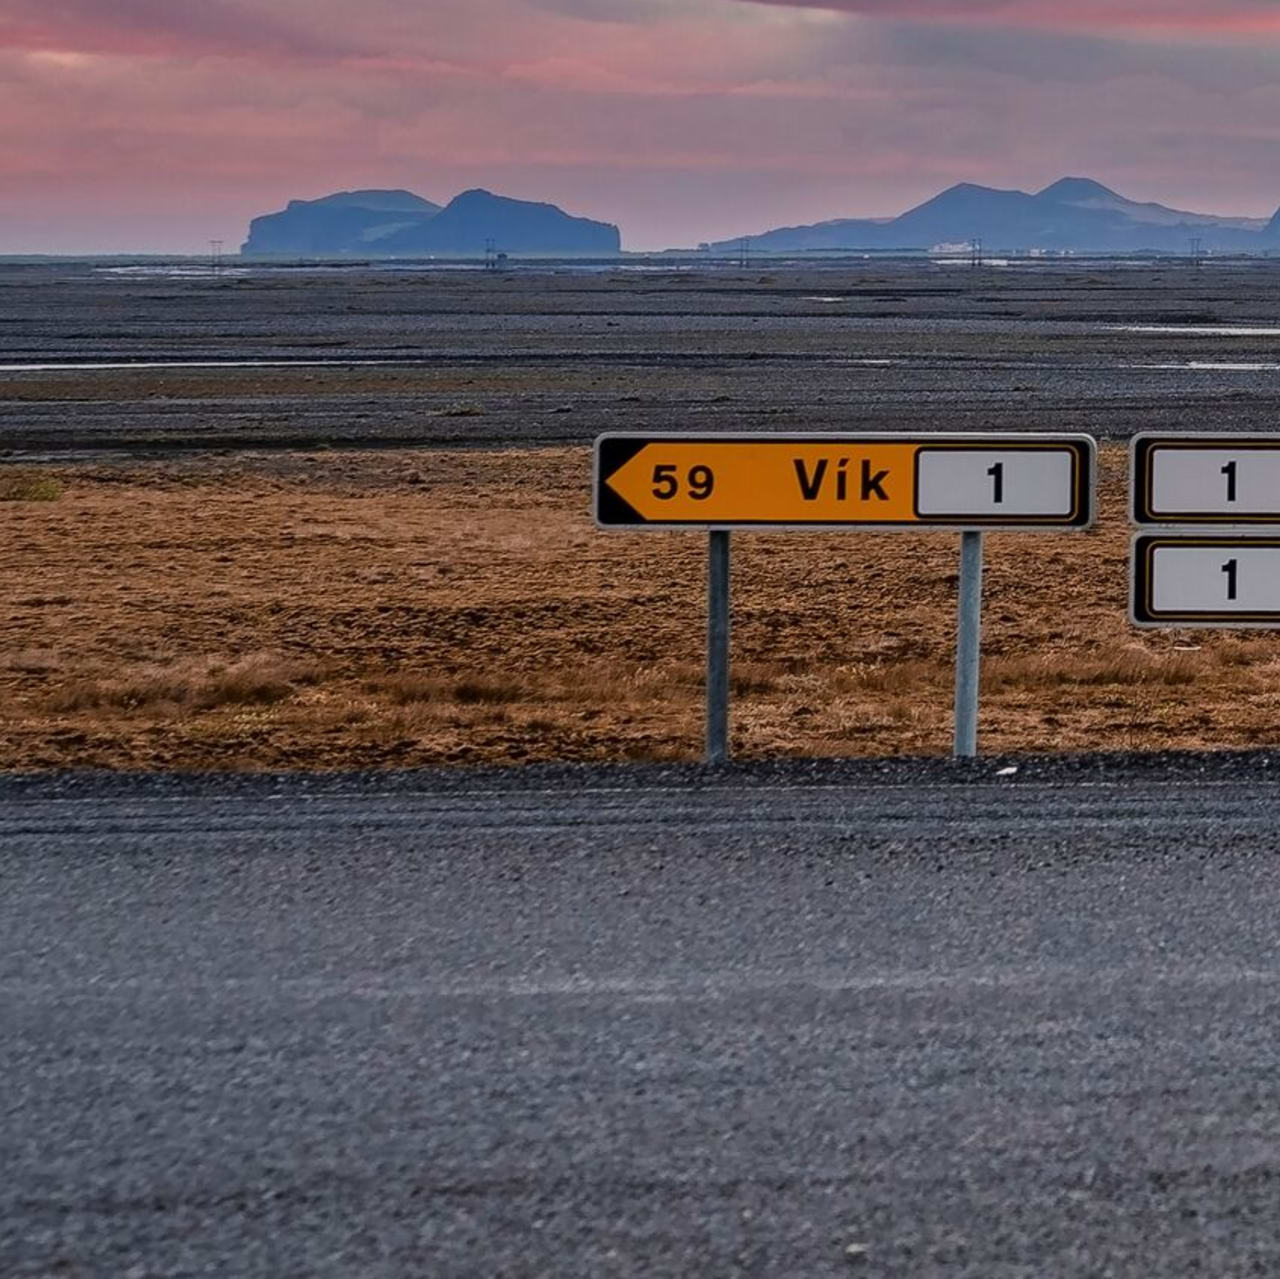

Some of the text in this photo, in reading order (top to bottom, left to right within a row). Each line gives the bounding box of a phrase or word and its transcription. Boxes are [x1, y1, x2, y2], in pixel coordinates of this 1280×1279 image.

[651, 458, 1004, 504] 59 Vík 1
[1219, 461, 1238, 502] 1
[1220, 558, 1238, 601] 1
